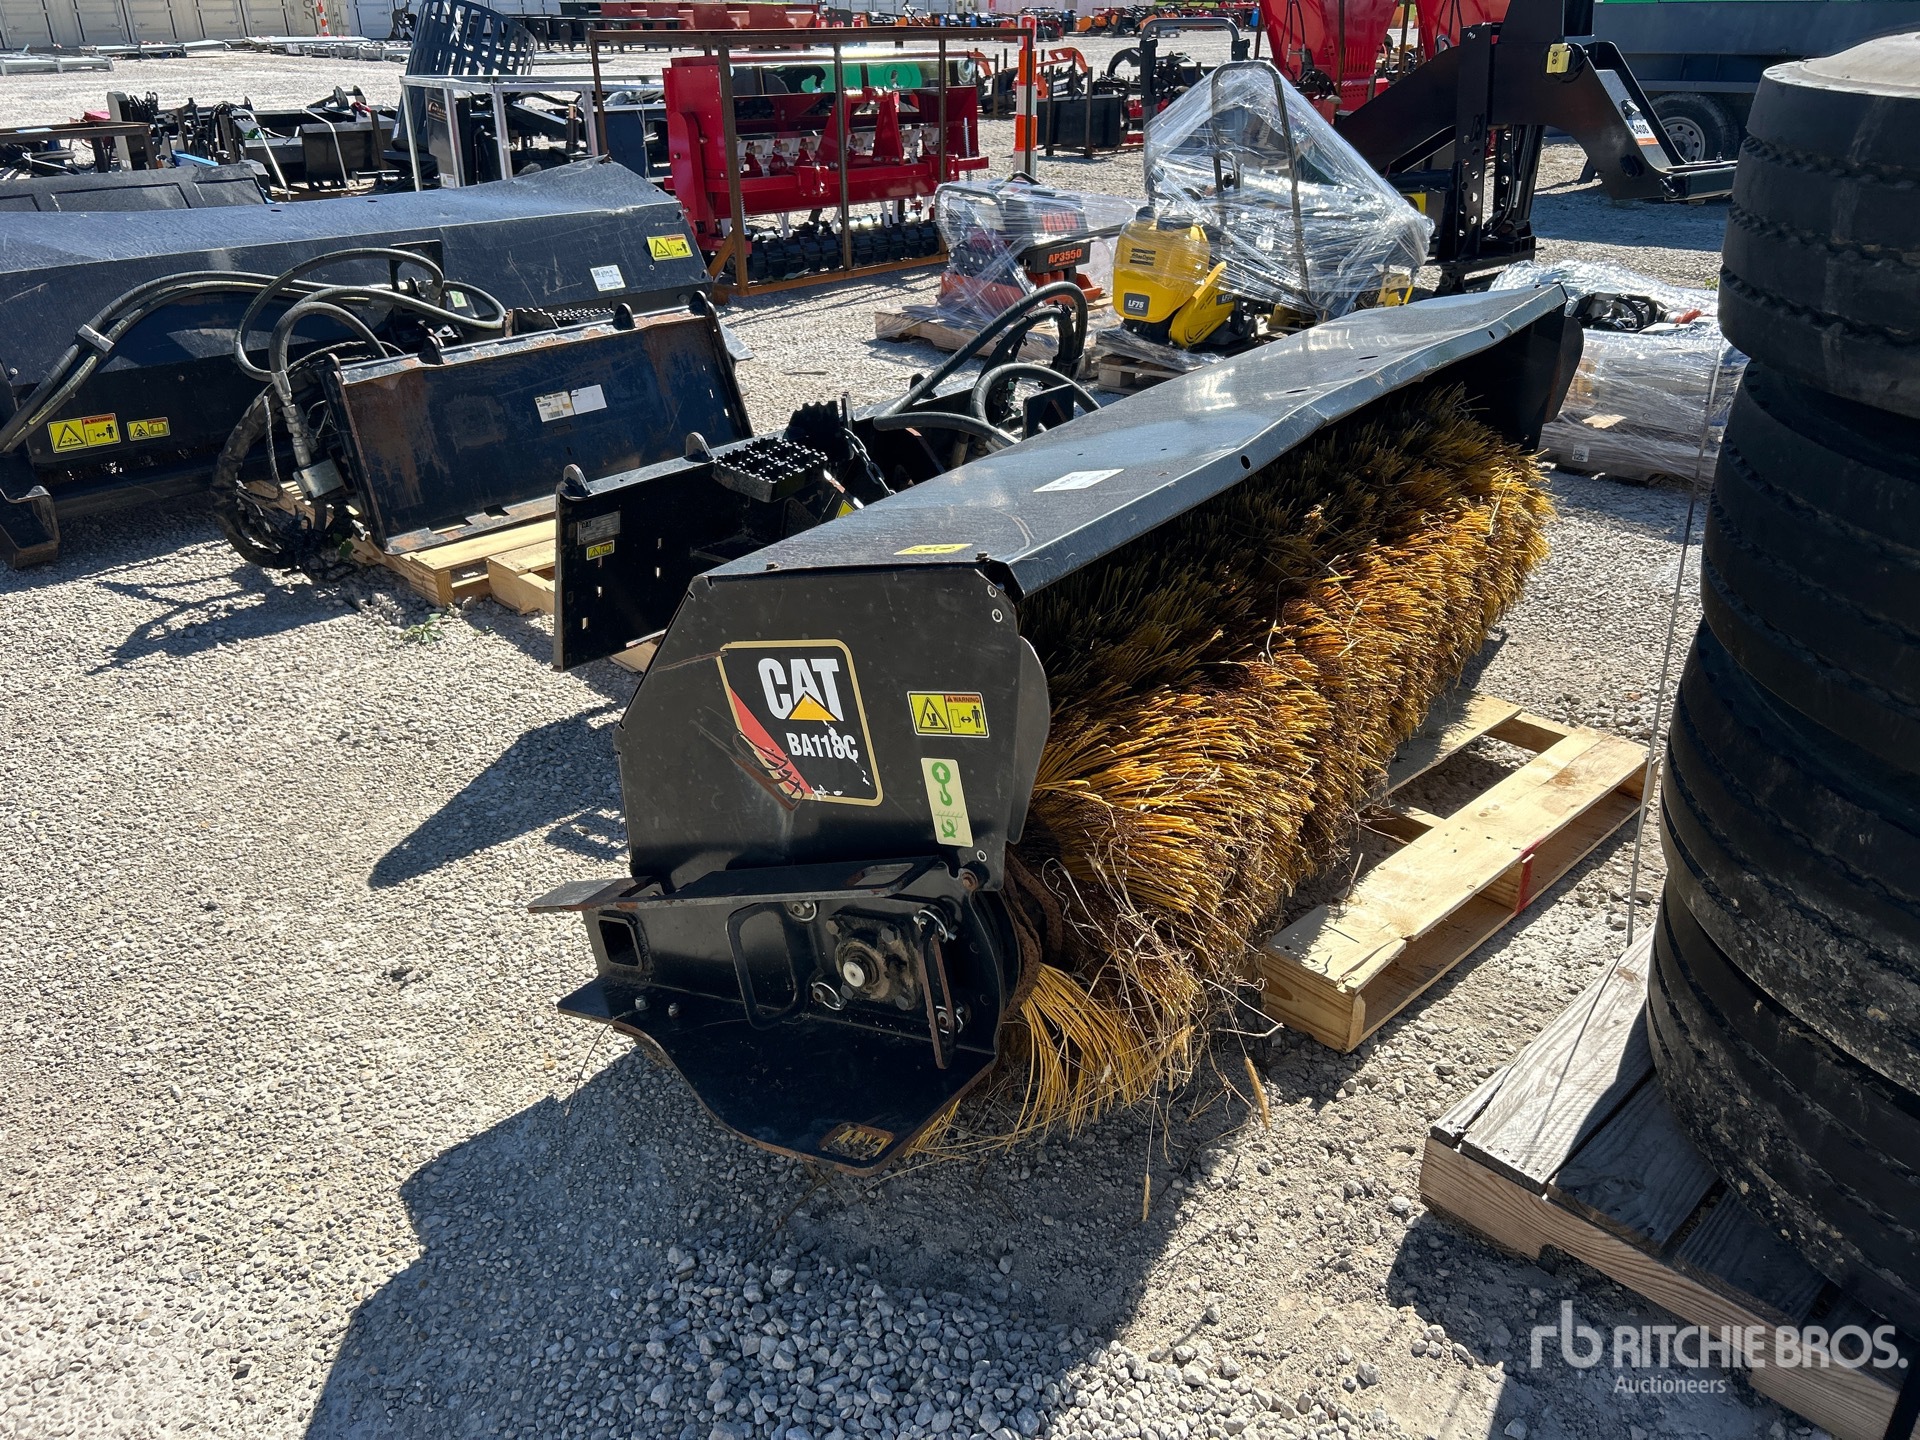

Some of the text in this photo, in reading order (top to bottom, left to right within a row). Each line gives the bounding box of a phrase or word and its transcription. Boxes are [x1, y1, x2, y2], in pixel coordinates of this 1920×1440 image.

[1048, 248, 1083, 264] AP3550
[1128, 299, 1144, 308] LF75
[757, 657, 844, 722] CAT
[786, 732, 859, 762] BA118C
